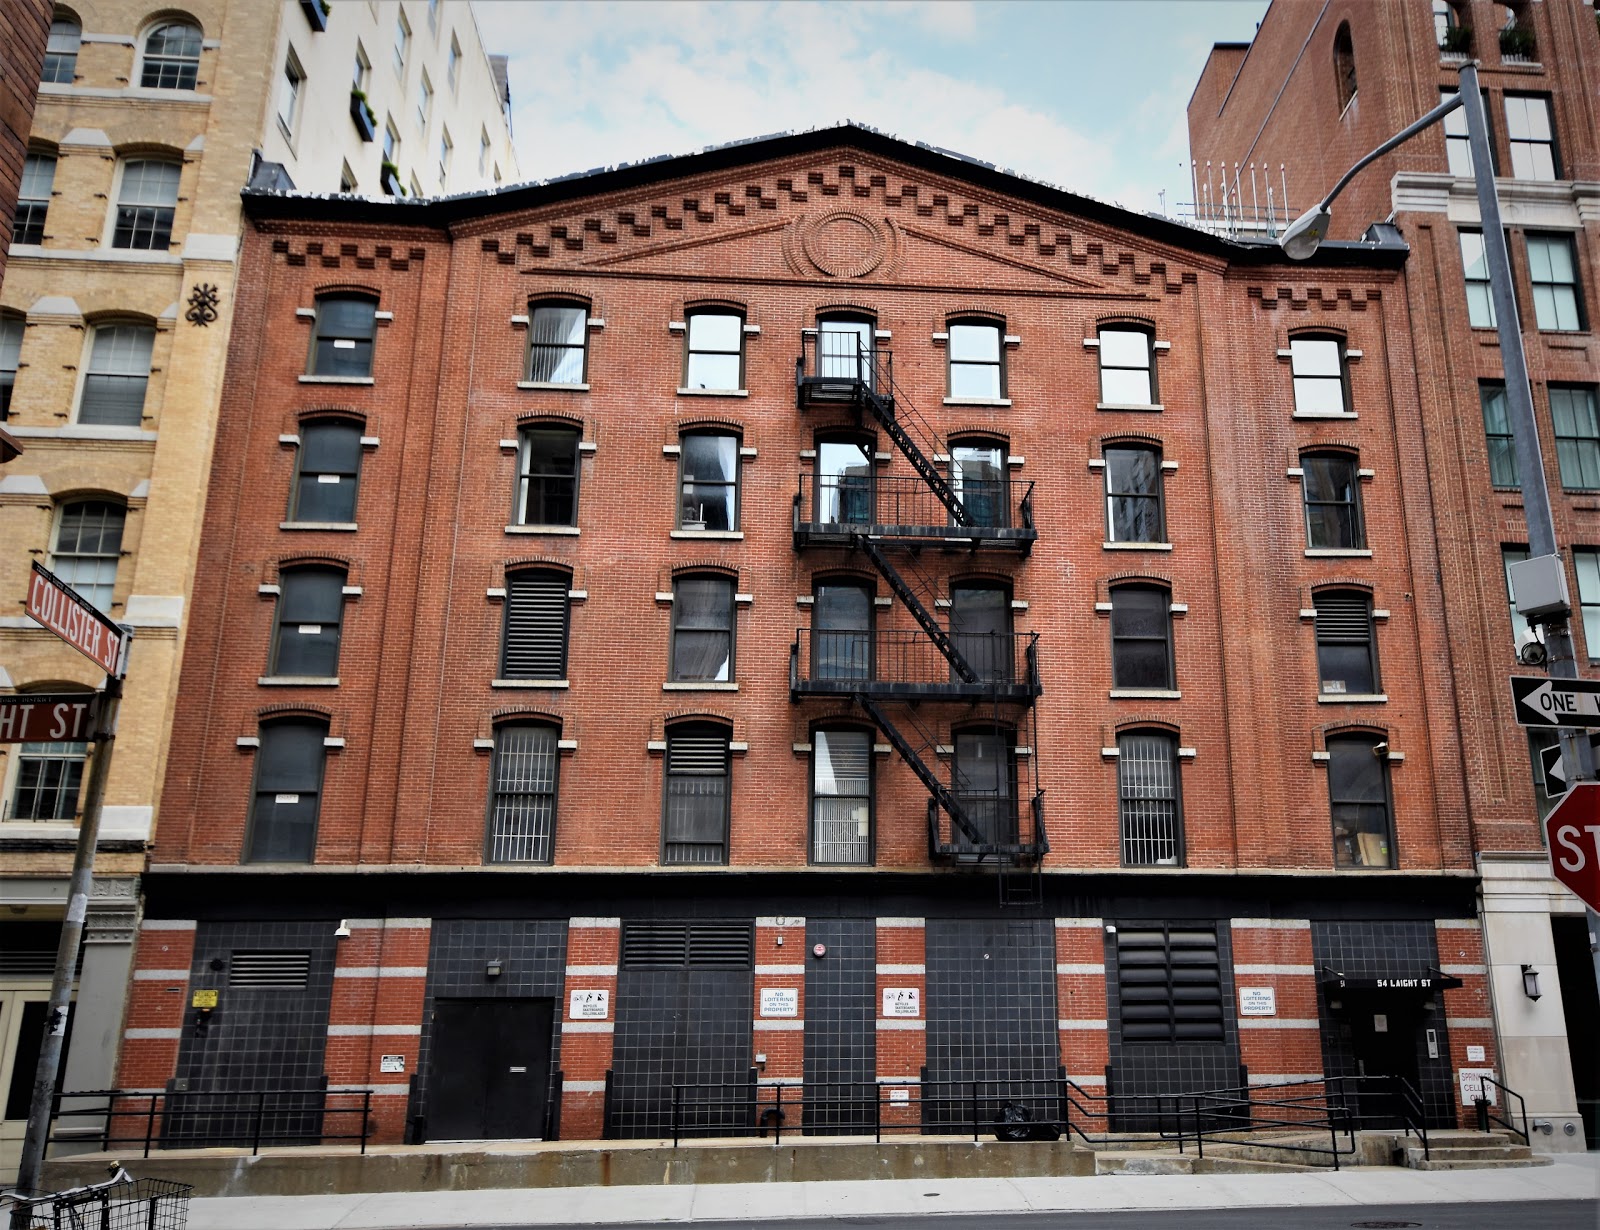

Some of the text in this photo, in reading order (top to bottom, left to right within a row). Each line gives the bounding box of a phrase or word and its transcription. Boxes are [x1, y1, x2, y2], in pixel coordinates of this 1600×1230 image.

[31, 574, 102, 659] COLLISTER
[104, 630, 120, 671] ST
[1540, 692, 1577, 712] ONE
[49, 702, 88, 739] ST
[1376, 979, 1431, 988] 54 LAIGHT ST
